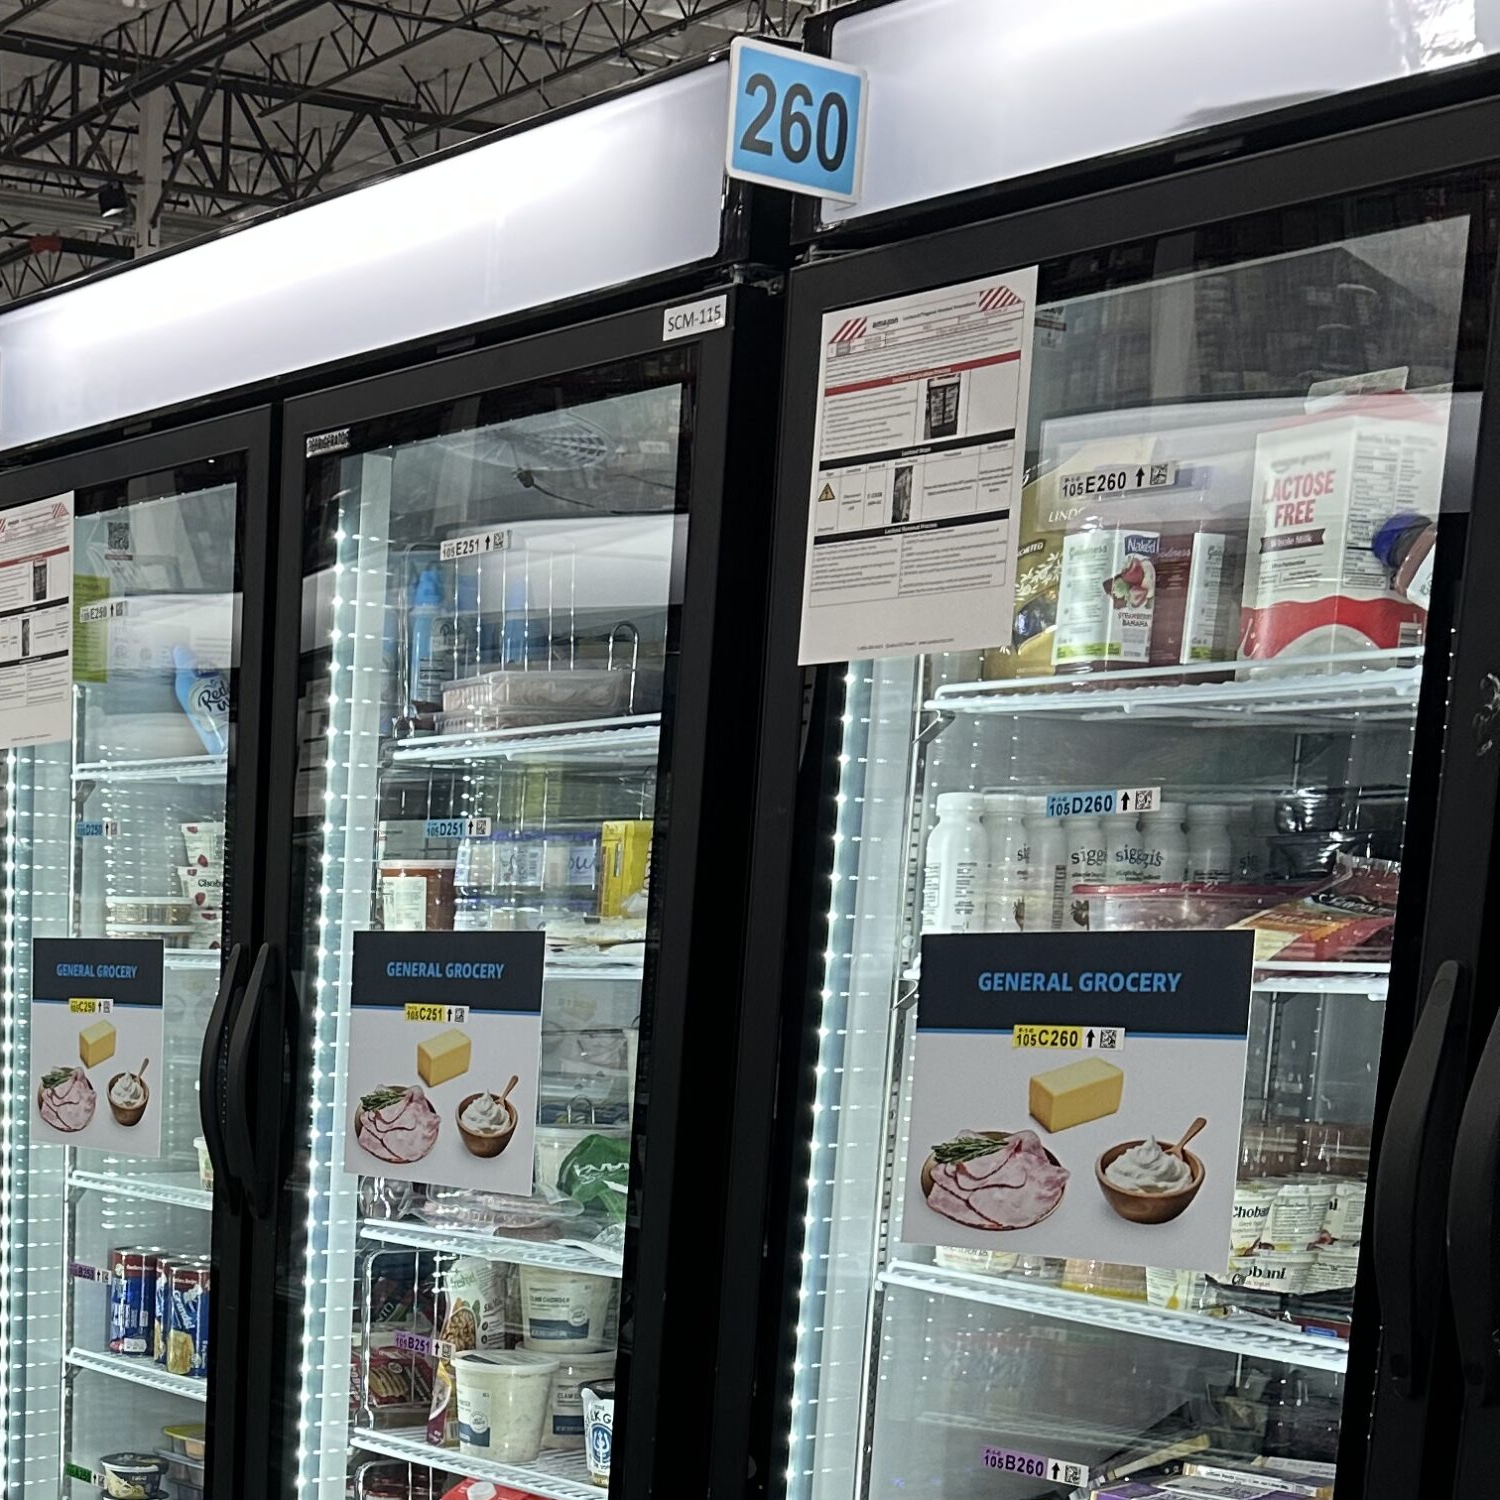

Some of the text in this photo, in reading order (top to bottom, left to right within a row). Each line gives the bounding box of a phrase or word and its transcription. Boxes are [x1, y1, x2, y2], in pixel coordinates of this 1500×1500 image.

[740, 73, 848, 172] 260
[667, 304, 722, 332] SCM-115
[1263, 469, 1336, 505] LACTOSE
[1275, 499, 1316, 528] FREE
[1049, 795, 1113, 816] 105D260
[56, 963, 138, 979] GENERAL GROCERY
[387, 962, 504, 979] GENERAL GROCERY
[978, 971, 1182, 993] GENERAL GROCERY
[1017, 1030, 1079, 1047] 105C260
[174, 1290, 196, 1330] Grands!
[984, 1454, 1044, 1477] 105B260
